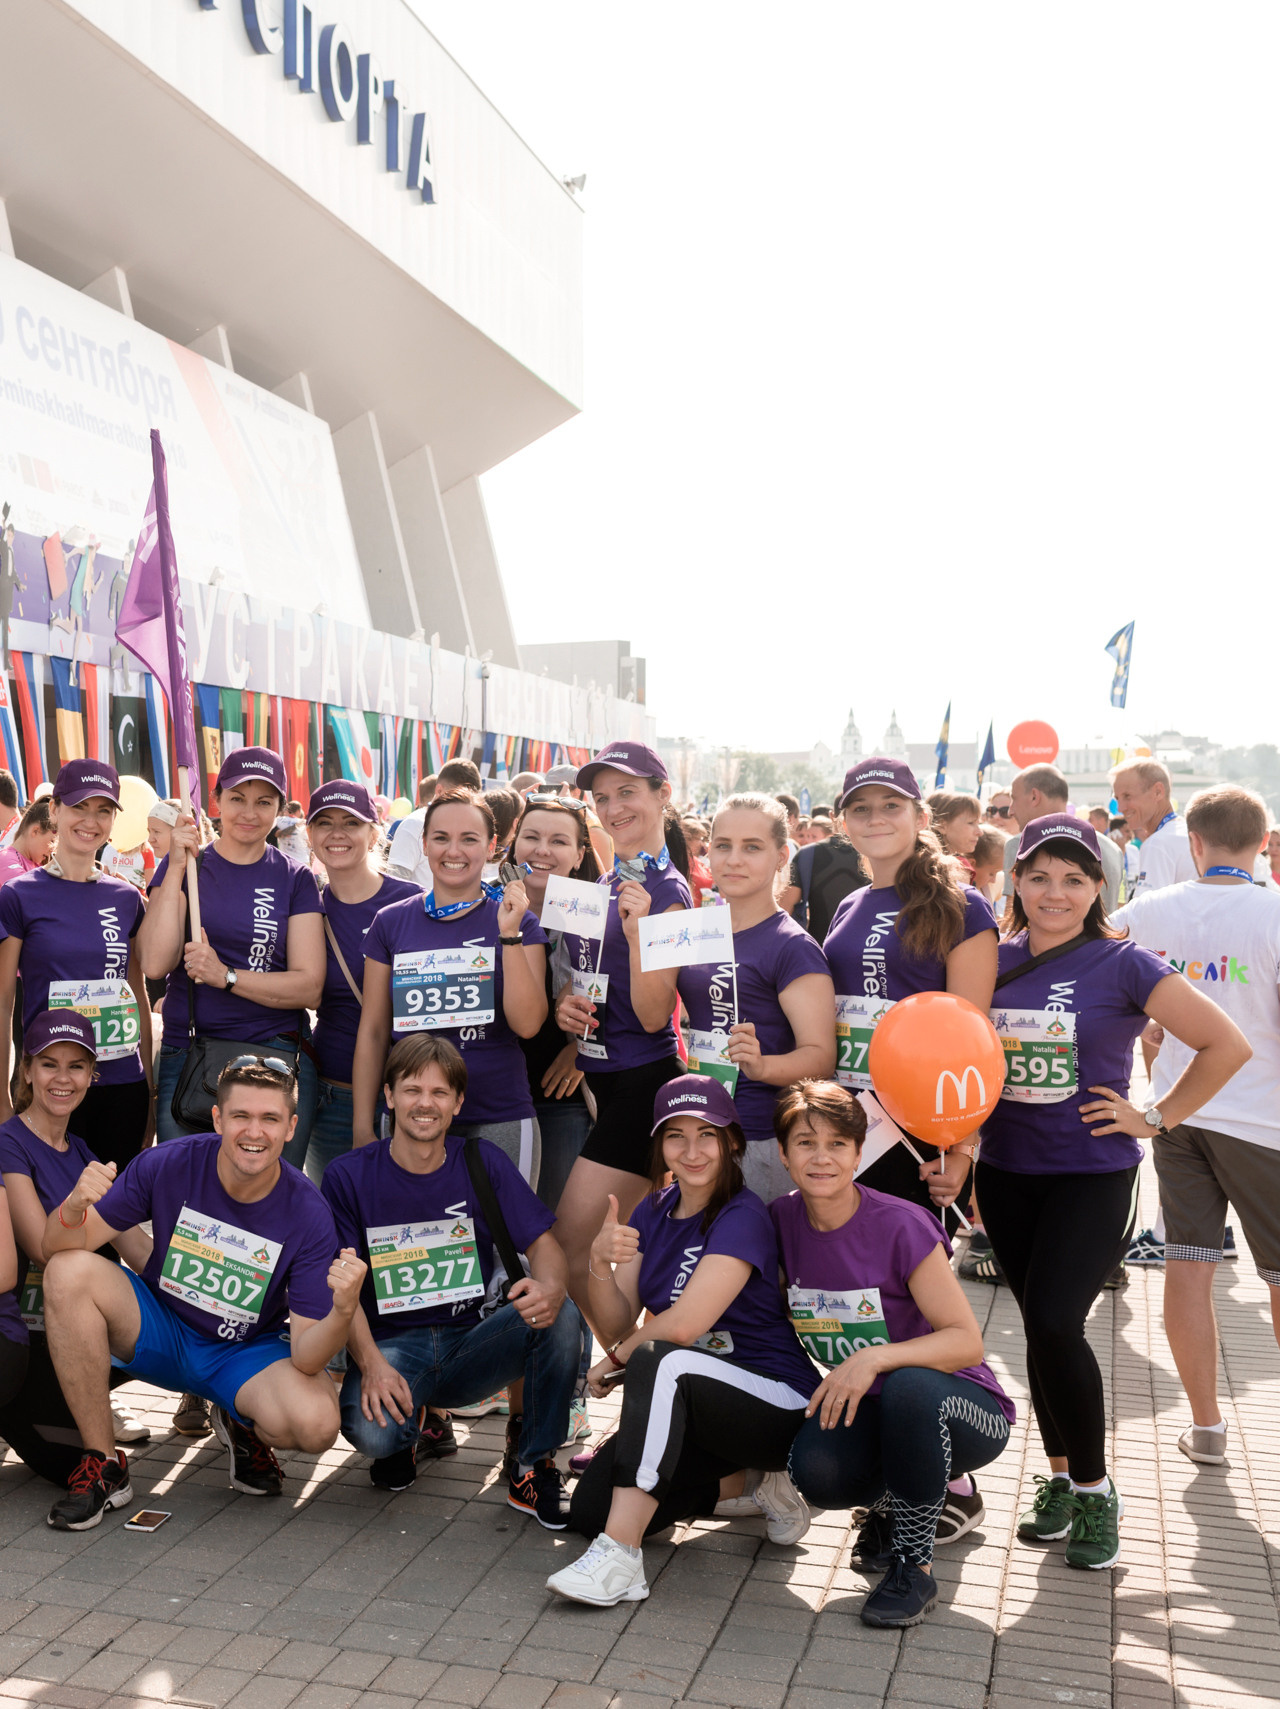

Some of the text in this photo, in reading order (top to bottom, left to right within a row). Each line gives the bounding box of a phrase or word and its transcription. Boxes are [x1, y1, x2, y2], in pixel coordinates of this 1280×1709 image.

[16, 305, 178, 427] сентября
[190, 578, 422, 716] УСТРАКАЕ
[1019, 744, 1053, 755] Lenovo
[241, 761, 274, 775] Wellness
[81, 775, 113, 789] Wellness
[855, 769, 895, 782] Wellness
[322, 793, 356, 803] Wellness
[1041, 825, 1082, 839] Wellness
[878, 962, 886, 975] BY
[422, 974, 443, 983] 2018
[405, 984, 481, 1014] 9353
[78, 1007, 97, 1015] 2018
[49, 1024, 84, 1037] Wellness
[1032, 1046, 1056, 1054] Natalia
[1005, 1056, 1071, 1085] 595
[668, 1094, 708, 1108] Wellness
[200, 1247, 221, 1261] 2018
[403, 1250, 424, 1259] 2018
[444, 1248, 462, 1256] Pavel
[221, 1259, 256, 1278] LEKSANDR
[378, 1256, 476, 1295] 13277
[170, 1253, 263, 1306] 12507
[821, 1321, 840, 1330] 2018
